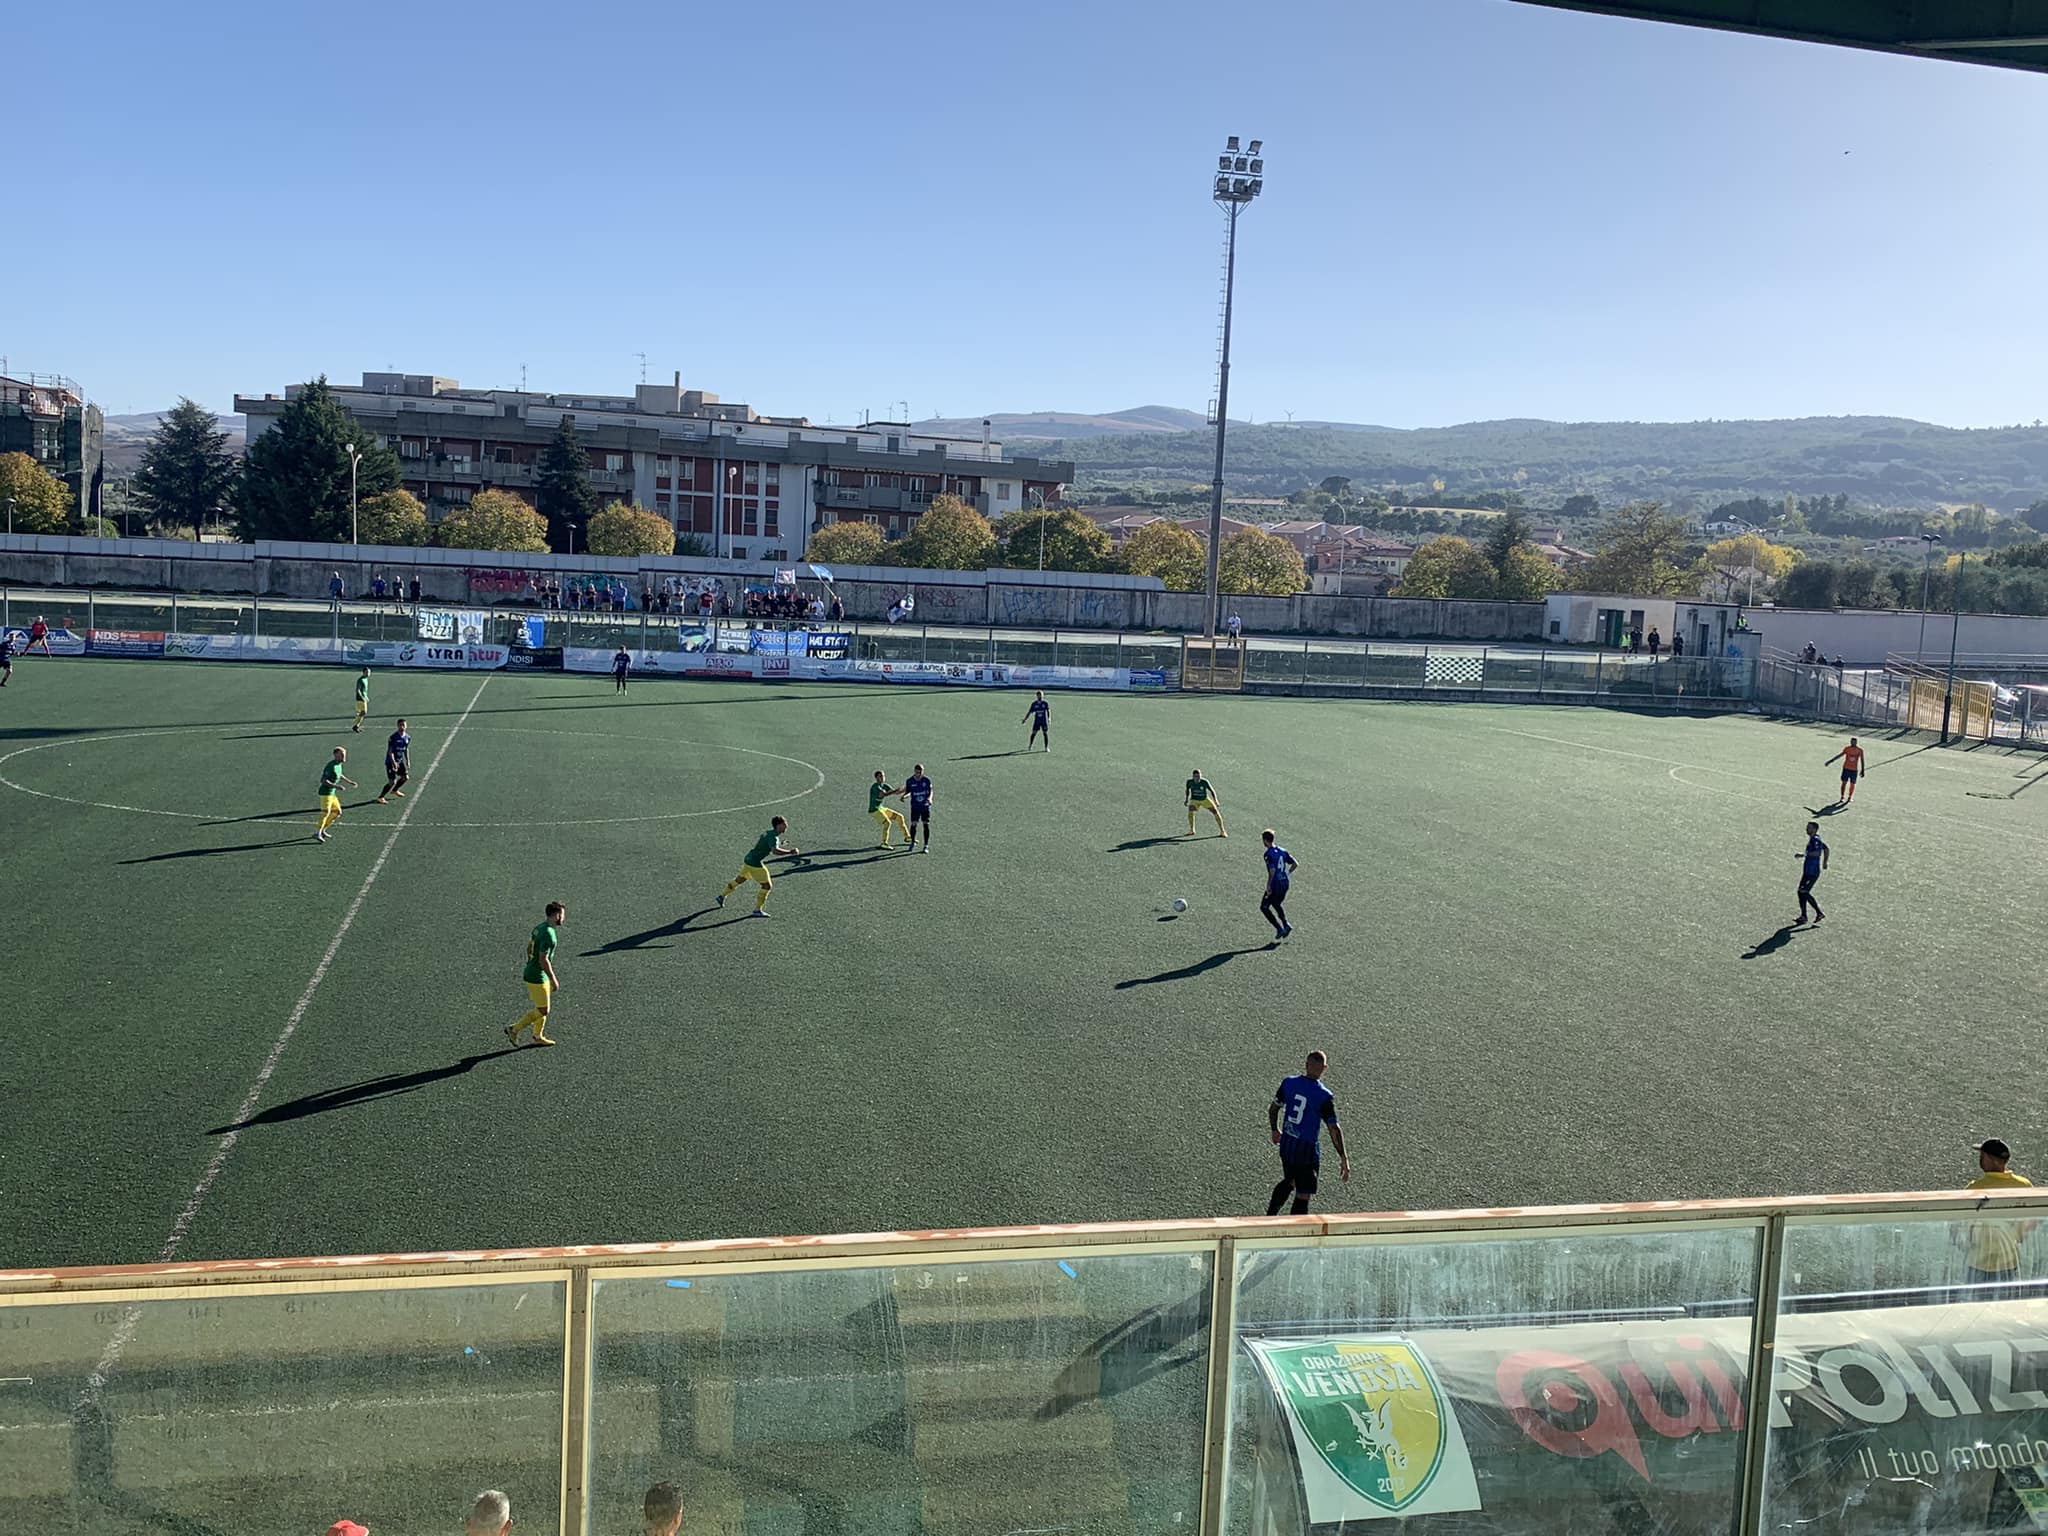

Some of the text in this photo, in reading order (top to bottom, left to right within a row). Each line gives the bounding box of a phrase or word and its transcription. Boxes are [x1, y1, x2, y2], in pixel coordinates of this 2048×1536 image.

[95, 631, 119, 640] NDS
[720, 629, 748, 639] Crazy
[428, 648, 463, 660] LYRA
[1277, 855, 1285, 872] 4
[1288, 1093, 1307, 1125] 3
[1291, 1362, 1422, 1398] VENOSA
[1858, 1434, 2048, 1479] Il tuo mondo
